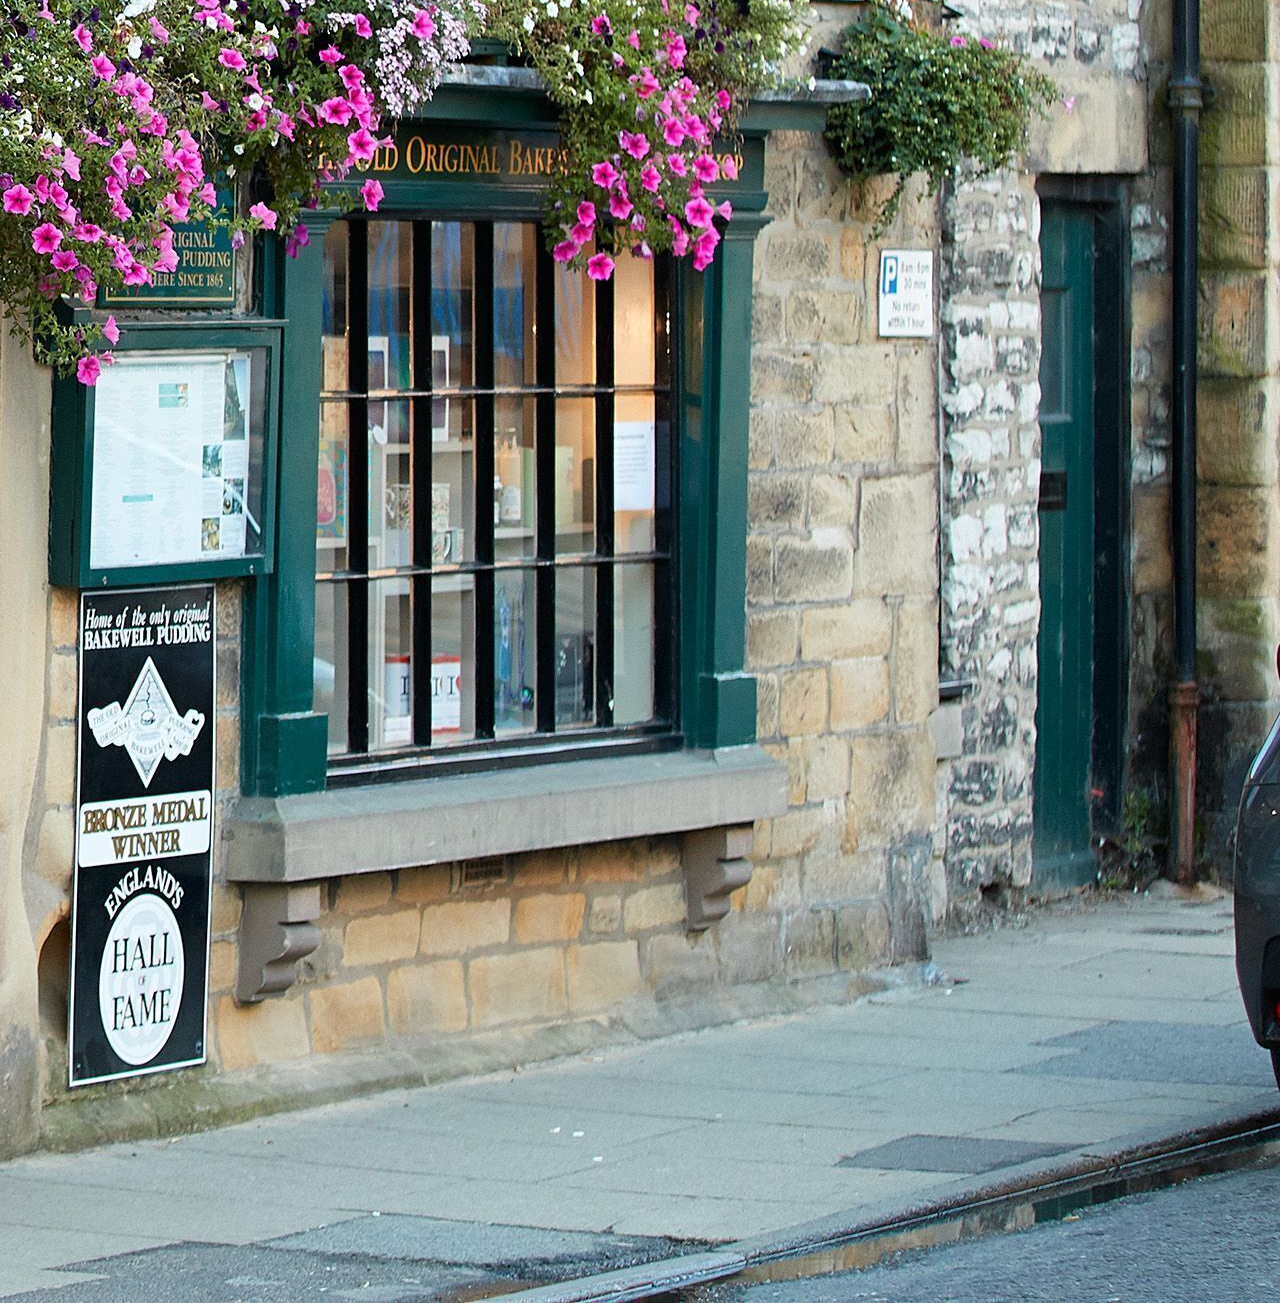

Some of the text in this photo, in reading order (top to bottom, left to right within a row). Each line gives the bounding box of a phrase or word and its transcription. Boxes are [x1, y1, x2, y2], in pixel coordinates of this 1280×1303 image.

[406, 136, 501, 175] ORIGINAL
[172, 232, 215, 248] RIGINAL
[182, 250, 231, 267] PUDDING
[178, 272, 204, 287] SINCE
[207, 274, 224, 288] 1865
[84, 601, 211, 630] Home of the only original
[84, 623, 211, 650] BAKEWELL PUDDING
[83, 797, 209, 834] BRONZE MEDAL
[111, 829, 181, 861] WINNER
[103, 864, 185, 921] ENGLAND'S
[112, 932, 174, 974] HALL
[112, 988, 171, 1031] FAME
